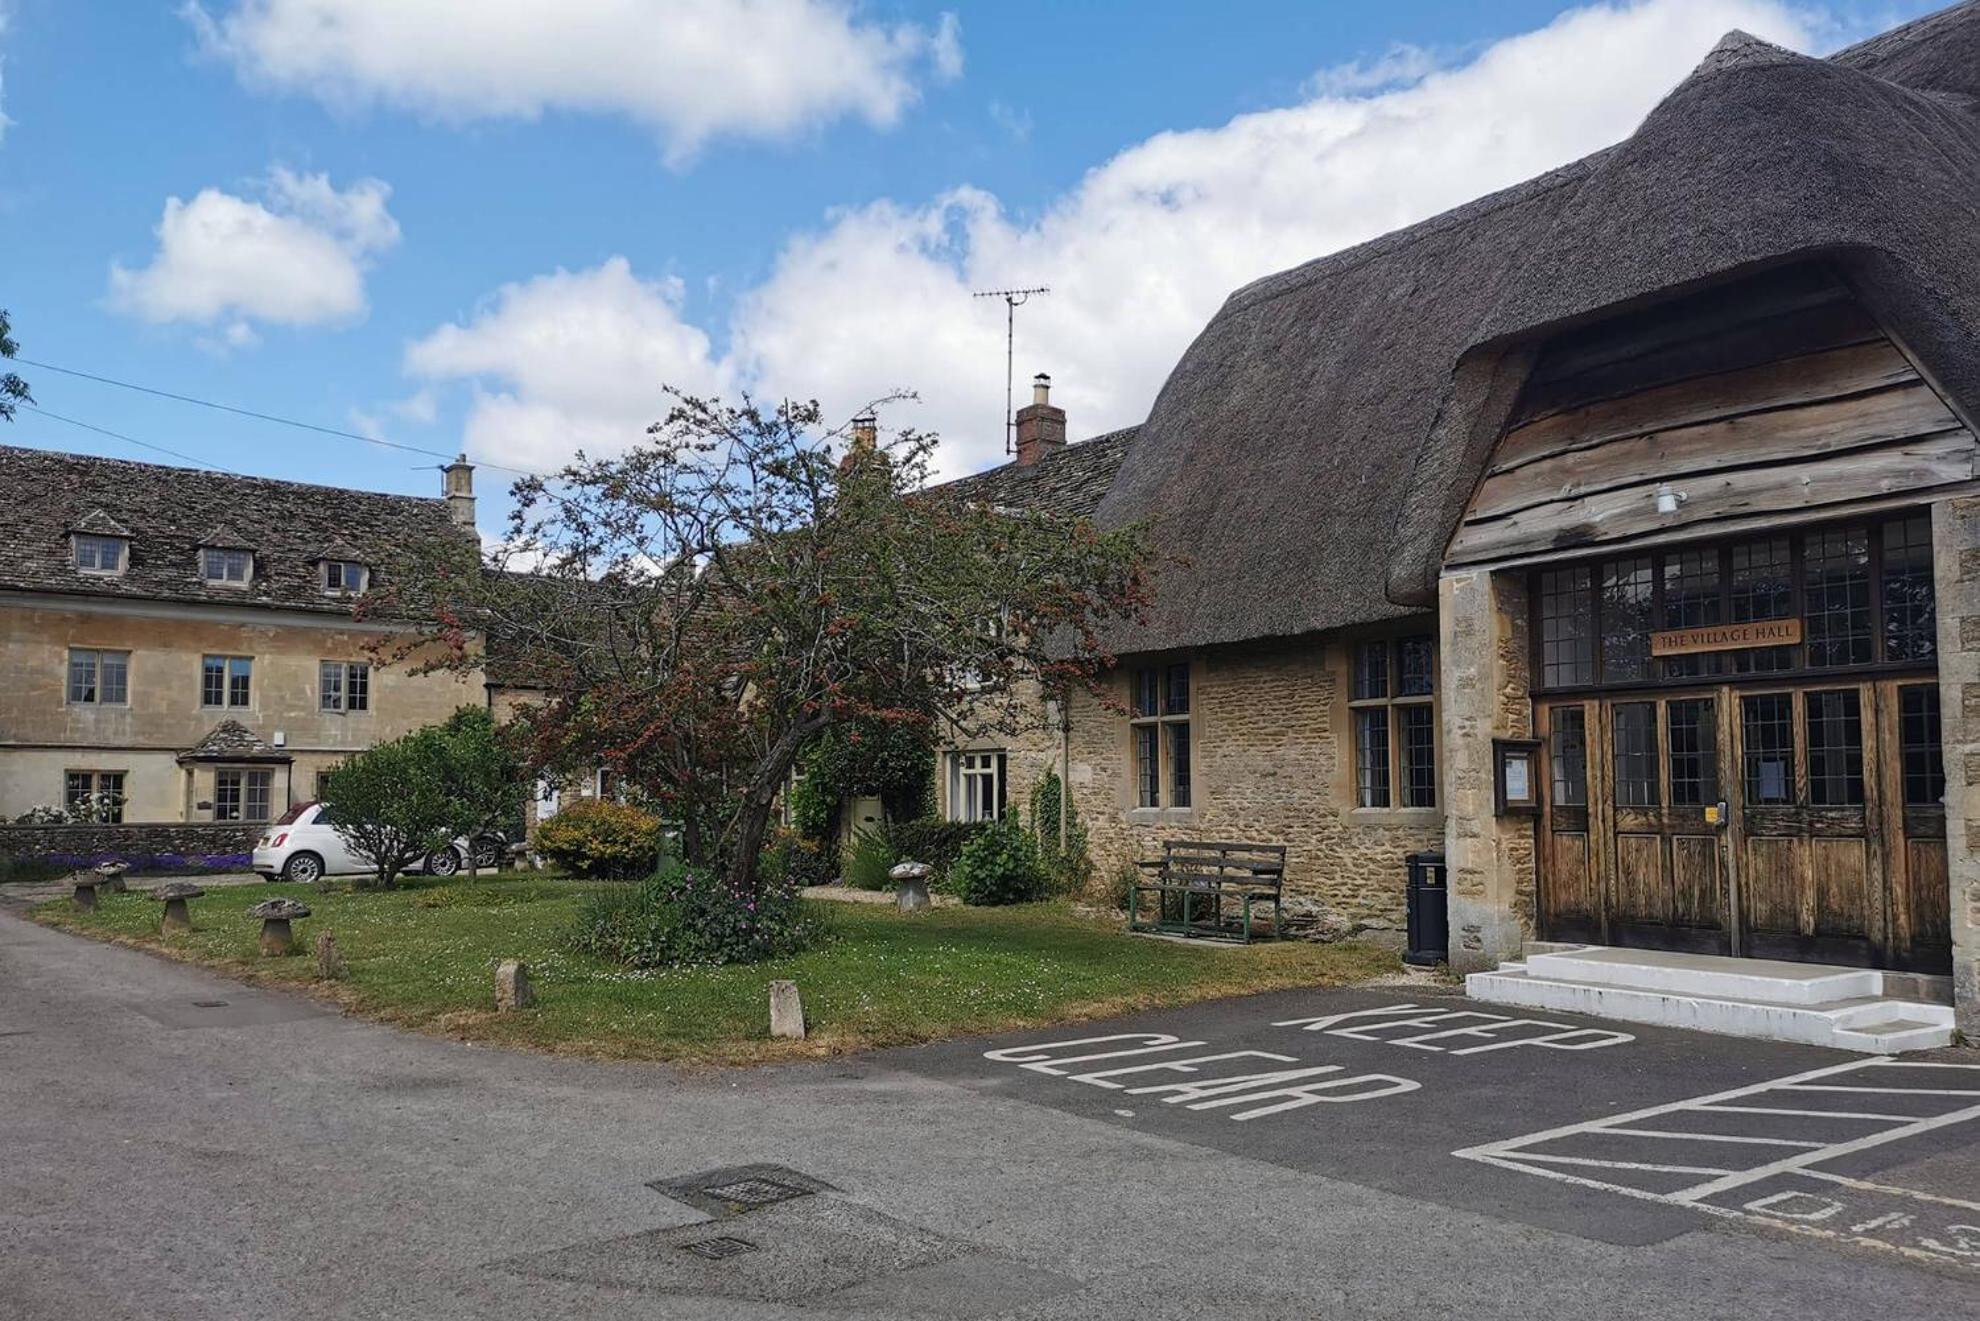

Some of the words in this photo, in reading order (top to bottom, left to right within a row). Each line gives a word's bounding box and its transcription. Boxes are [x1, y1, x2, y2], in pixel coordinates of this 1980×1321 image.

[1660, 634, 1688, 649] THE
[1691, 628, 1750, 645] VILLAGE
[1755, 625, 1793, 640] HALL
[1270, 1003, 1636, 1056] KEEP
[983, 1033, 1422, 1121] CLEAR
